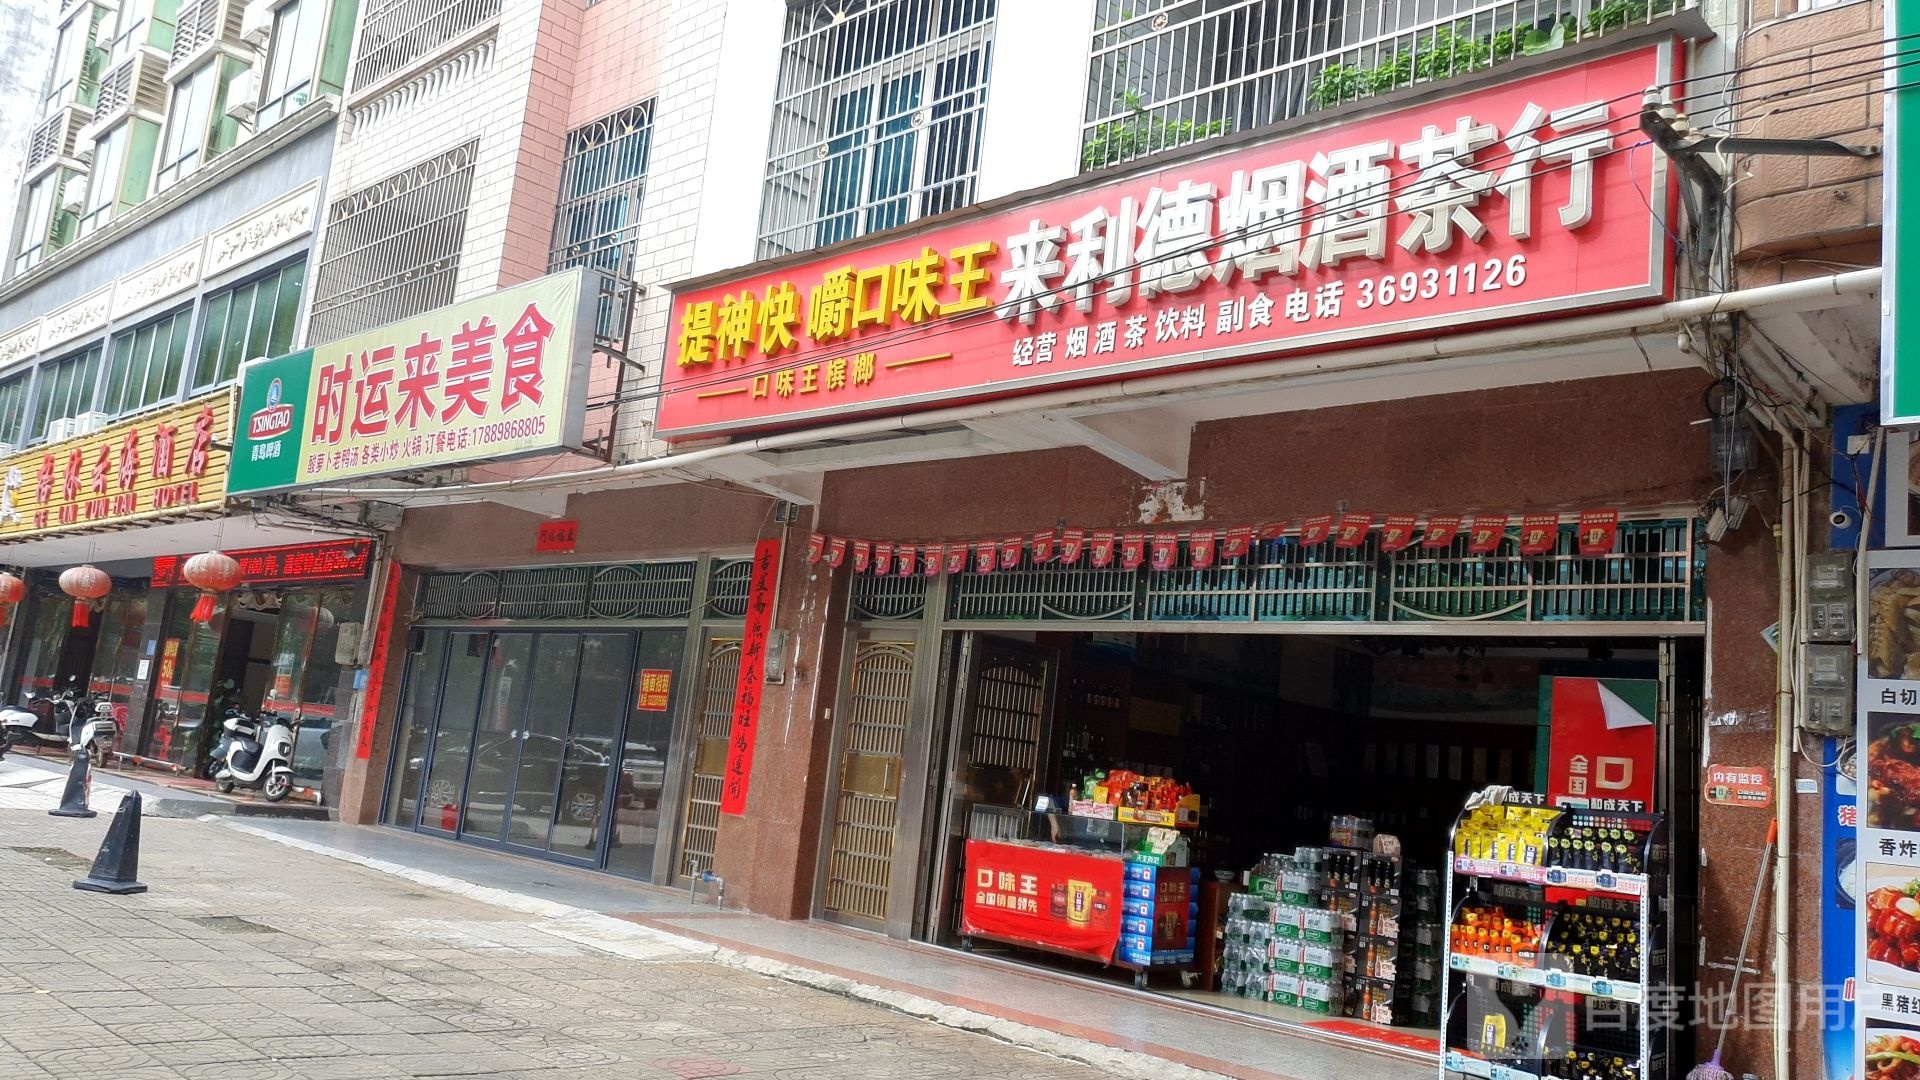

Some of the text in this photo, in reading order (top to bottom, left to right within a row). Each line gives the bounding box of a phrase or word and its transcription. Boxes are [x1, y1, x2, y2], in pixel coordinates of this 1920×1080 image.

[1002, 101, 1614, 323] 来利德烟酒茶行
[677, 240, 999, 368] 提神快 嚼口味王
[1012, 255, 1528, 367] 经营 烟 酒 茶 饮料 副食 电话 36931126
[311, 302, 555, 444] 时运来美食
[752, 353, 876, 399] 口味王槟榔
[251, 412, 290, 435] TSINGTAO
[250, 441, 282, 462] 青岛啤酒
[307, 453, 359, 474] 酸萝卜老鸭汤
[361, 447, 399, 467] 各类小炒
[401, 442, 423, 460] 火锅
[153, 482, 199, 509] HOTEL
[1881, 688, 1917, 706] 白切
[1568, 754, 1589, 795] 全国
[1595, 756, 1634, 790] 口
[1713, 771, 1763, 785] 内有监控
[1507, 792, 1545, 805] 成天下
[1590, 797, 1644, 813] 和成天下
[1879, 838, 1920, 858] 香炸
[977, 868, 1038, 896] 口味王
[976, 891, 1038, 913] 全国销量领先
